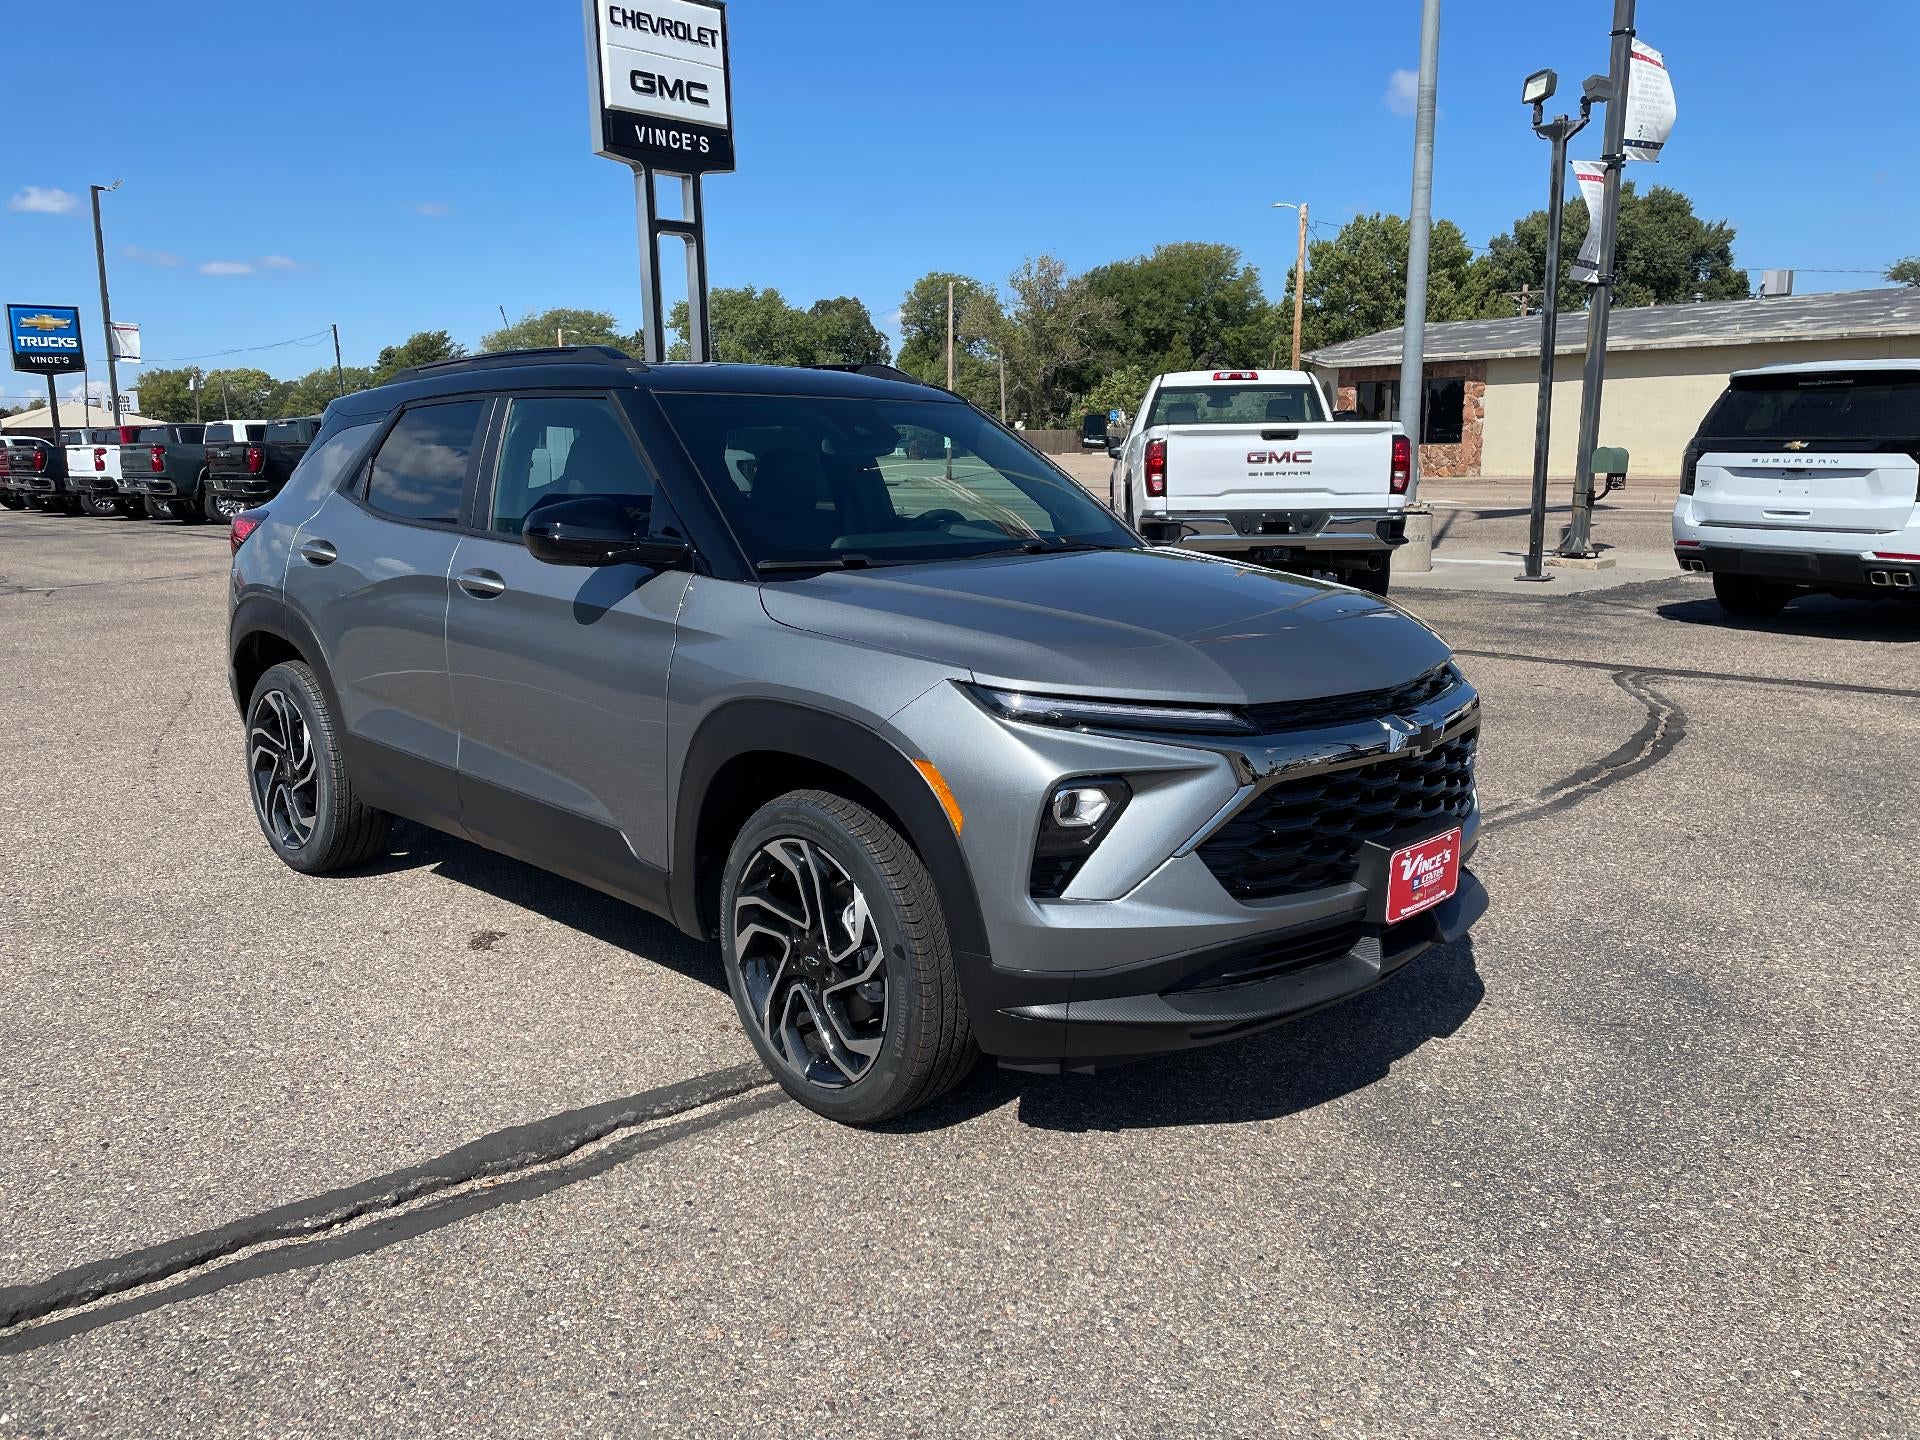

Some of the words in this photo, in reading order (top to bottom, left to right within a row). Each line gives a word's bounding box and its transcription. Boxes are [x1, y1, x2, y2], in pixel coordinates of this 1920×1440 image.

[609, 5, 719, 48] CHEVROLET
[630, 69, 710, 106] GMC
[635, 124, 710, 153] VINCE'S
[18, 336, 78, 348] TRUCKS
[30, 356, 70, 364] VINCE'S
[1247, 451, 1313, 464] GMC
[1400, 848, 1452, 881] VINCE'S
